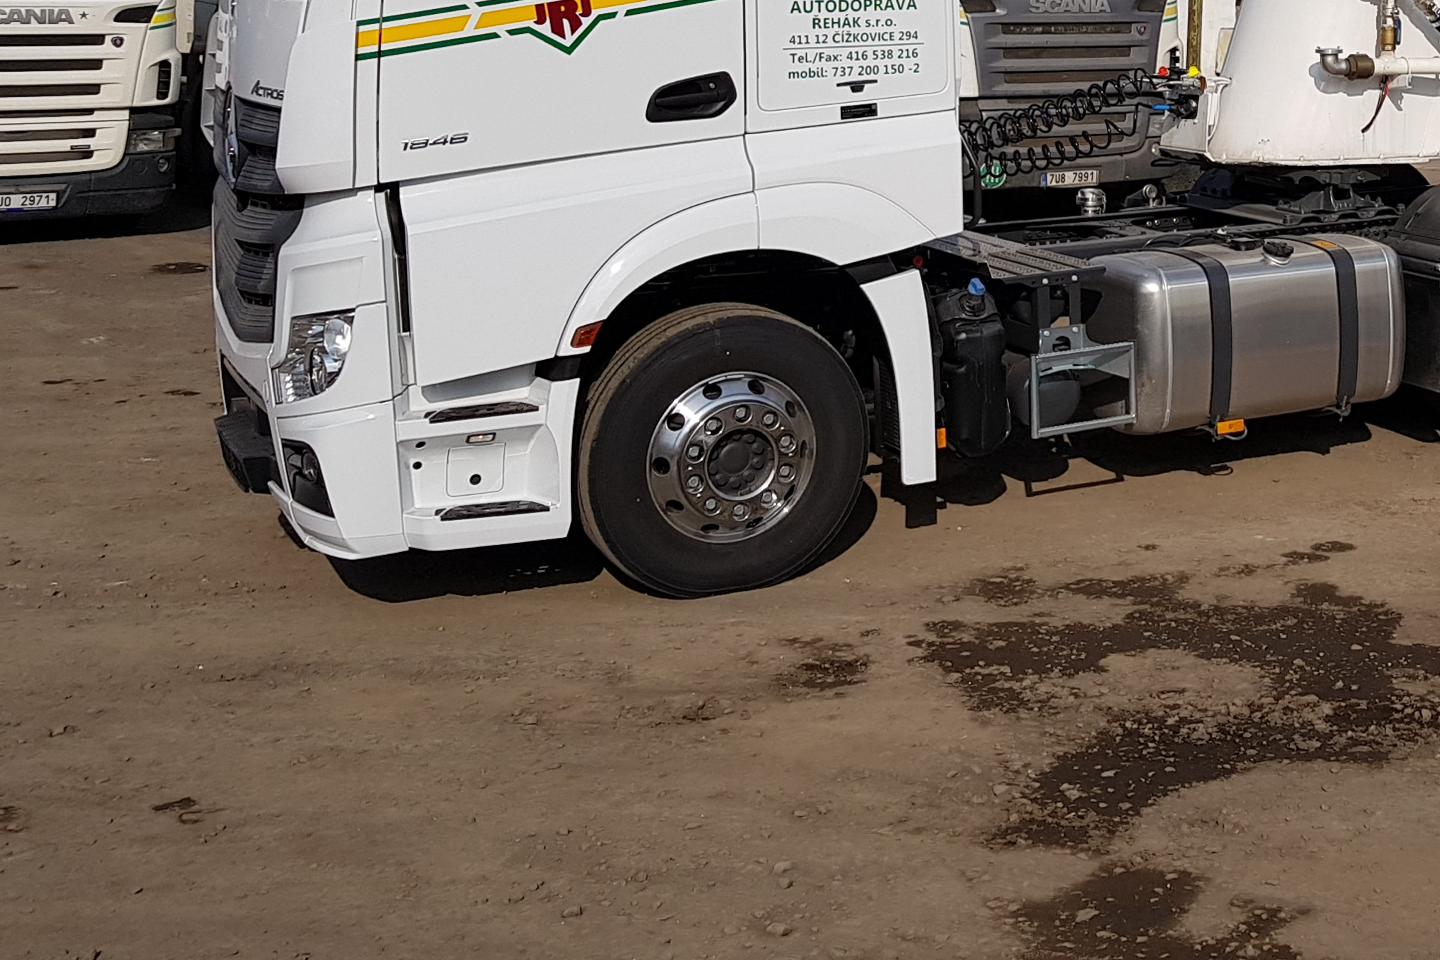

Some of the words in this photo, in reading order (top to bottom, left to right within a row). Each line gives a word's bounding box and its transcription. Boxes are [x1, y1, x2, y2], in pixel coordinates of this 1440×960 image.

[812, 14, 862, 29] ŘEHÁK
[864, 18, 897, 28] s.r.o.
[789, 35, 811, 45] 411
[814, 34, 829, 44] 12
[832, 30, 895, 43] ČÍŽKOVICE
[898, 31, 919, 41] 294
[790, 52, 843, 64] Tel./Fax:
[846, 51, 868, 61] 416
[872, 49, 894, 60] 538
[897, 48, 919, 59] 216
[788, 67, 828, 79] mobil:
[831, 66, 854, 77] 737
[858, 65, 880, 76] 200
[883, 64, 905, 75] 150
[401, 132, 469, 151] 1846
[1049, 173, 1066, 185] 7U8
[1072, 171, 1094, 183] 7991
[21, 194, 50, 206] 2971
